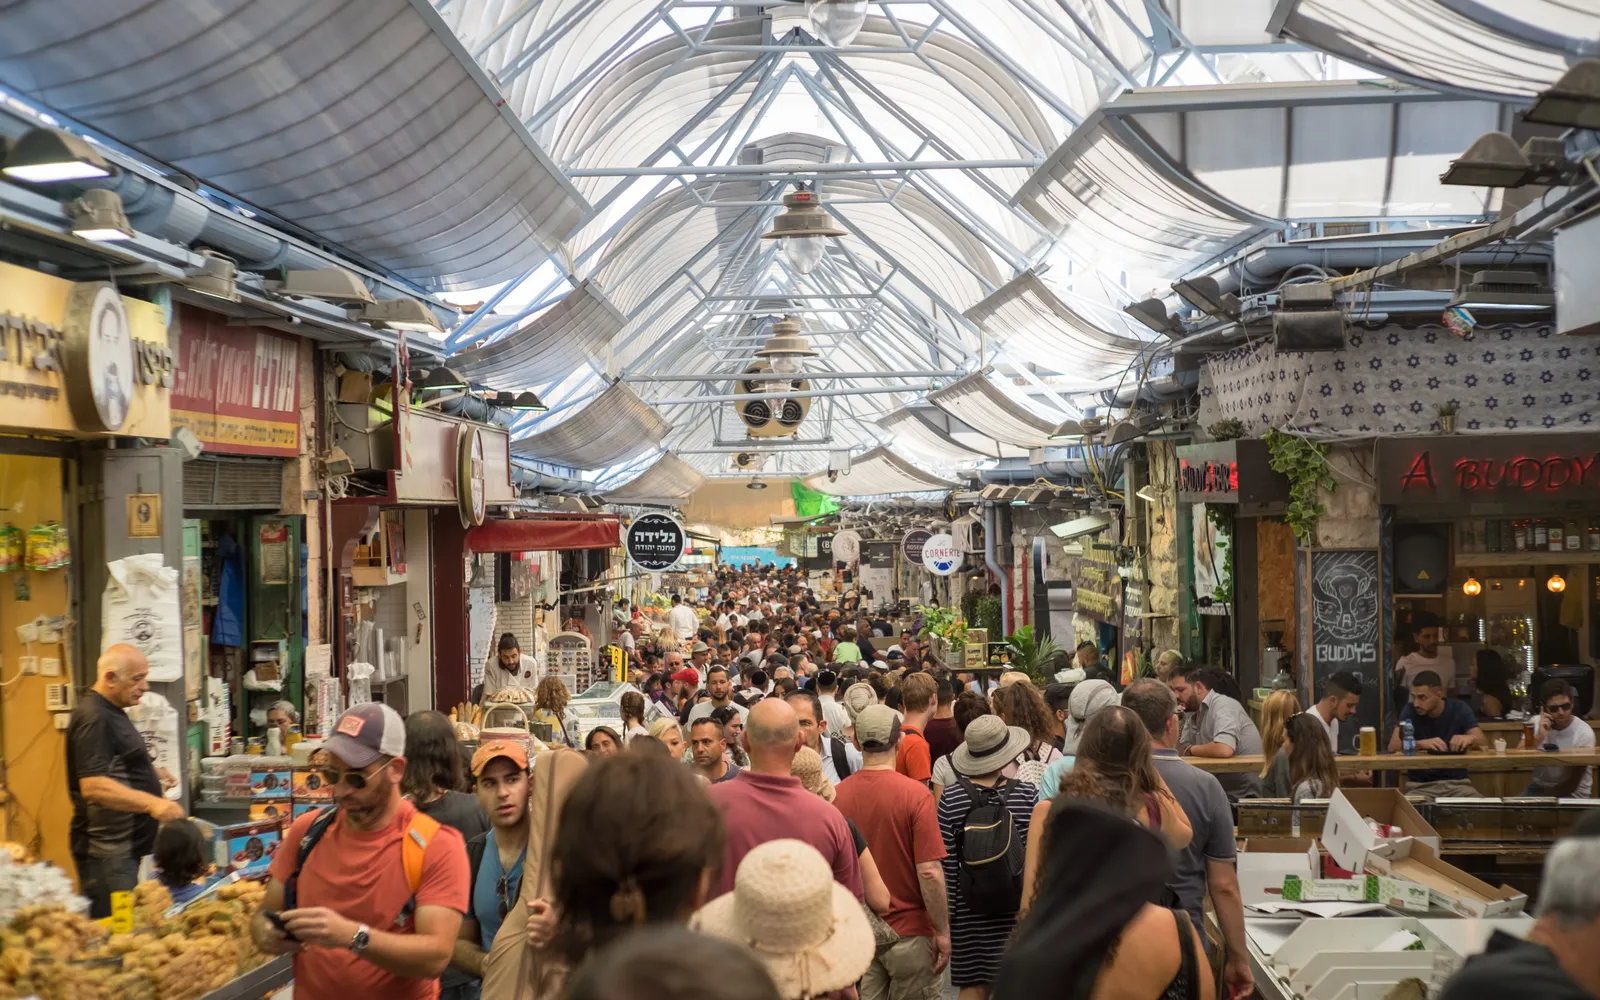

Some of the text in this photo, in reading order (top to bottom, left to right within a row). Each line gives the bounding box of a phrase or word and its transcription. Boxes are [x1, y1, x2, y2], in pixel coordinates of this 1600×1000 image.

[1400, 450, 1437, 493] A
[634, 529, 676, 543] גלידה
[656, 544, 676, 552] מחנה
[1315, 642, 1377, 663] BUDDYS
